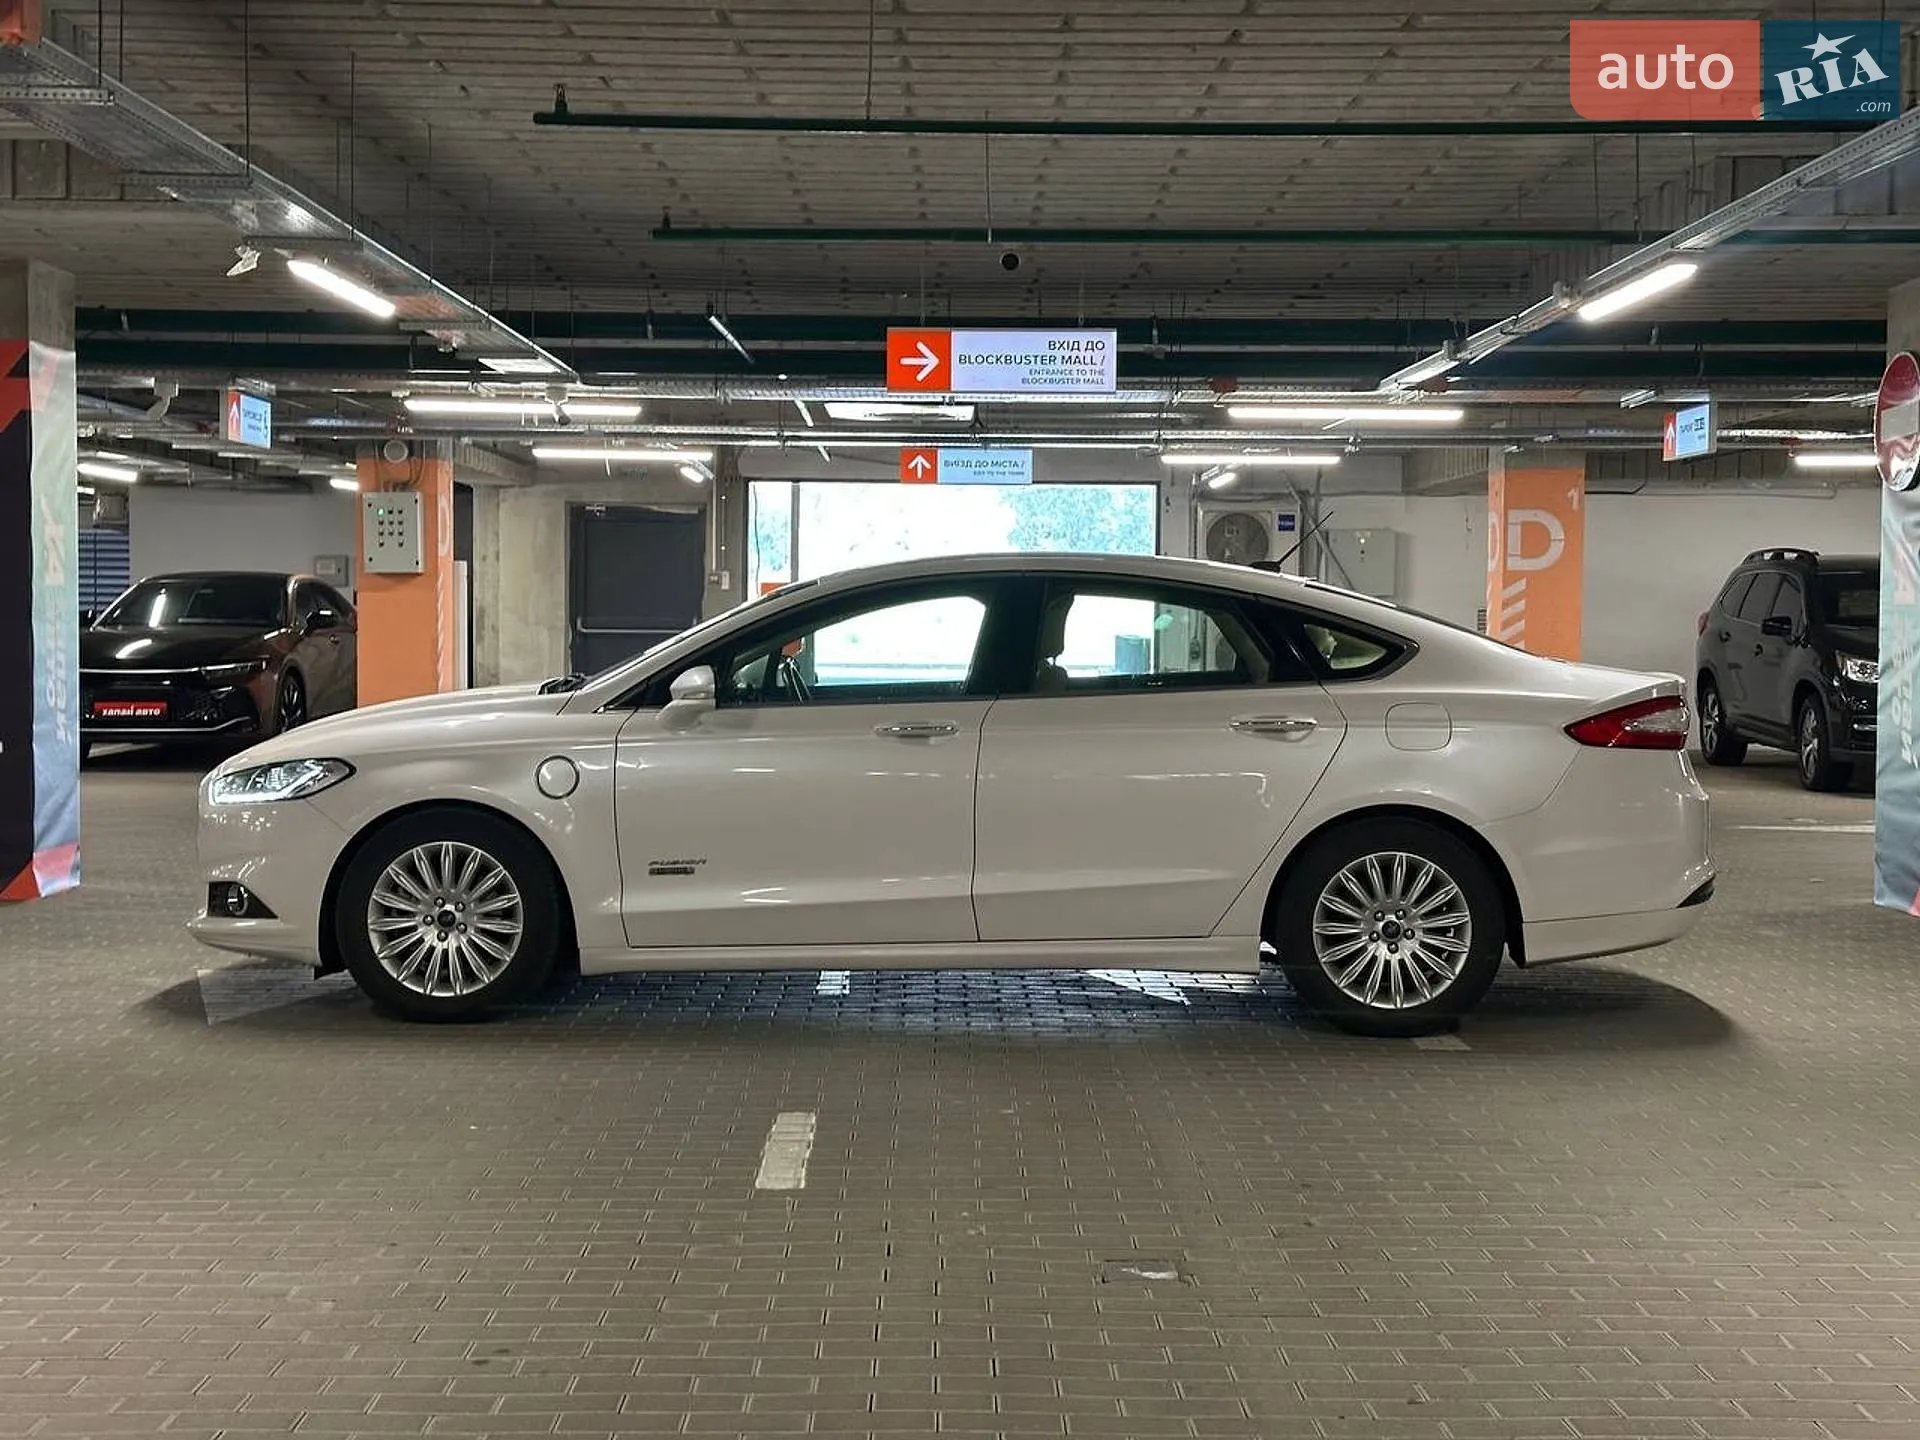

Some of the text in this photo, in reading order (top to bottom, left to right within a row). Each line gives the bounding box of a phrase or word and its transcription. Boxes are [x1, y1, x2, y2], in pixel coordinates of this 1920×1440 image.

[1049, 340, 1105, 352] ВХІД ДО
[958, 354, 1057, 365] BLOCKBUSTER
[1061, 354, 1097, 365] MALL
[1507, 509, 1564, 571] D
